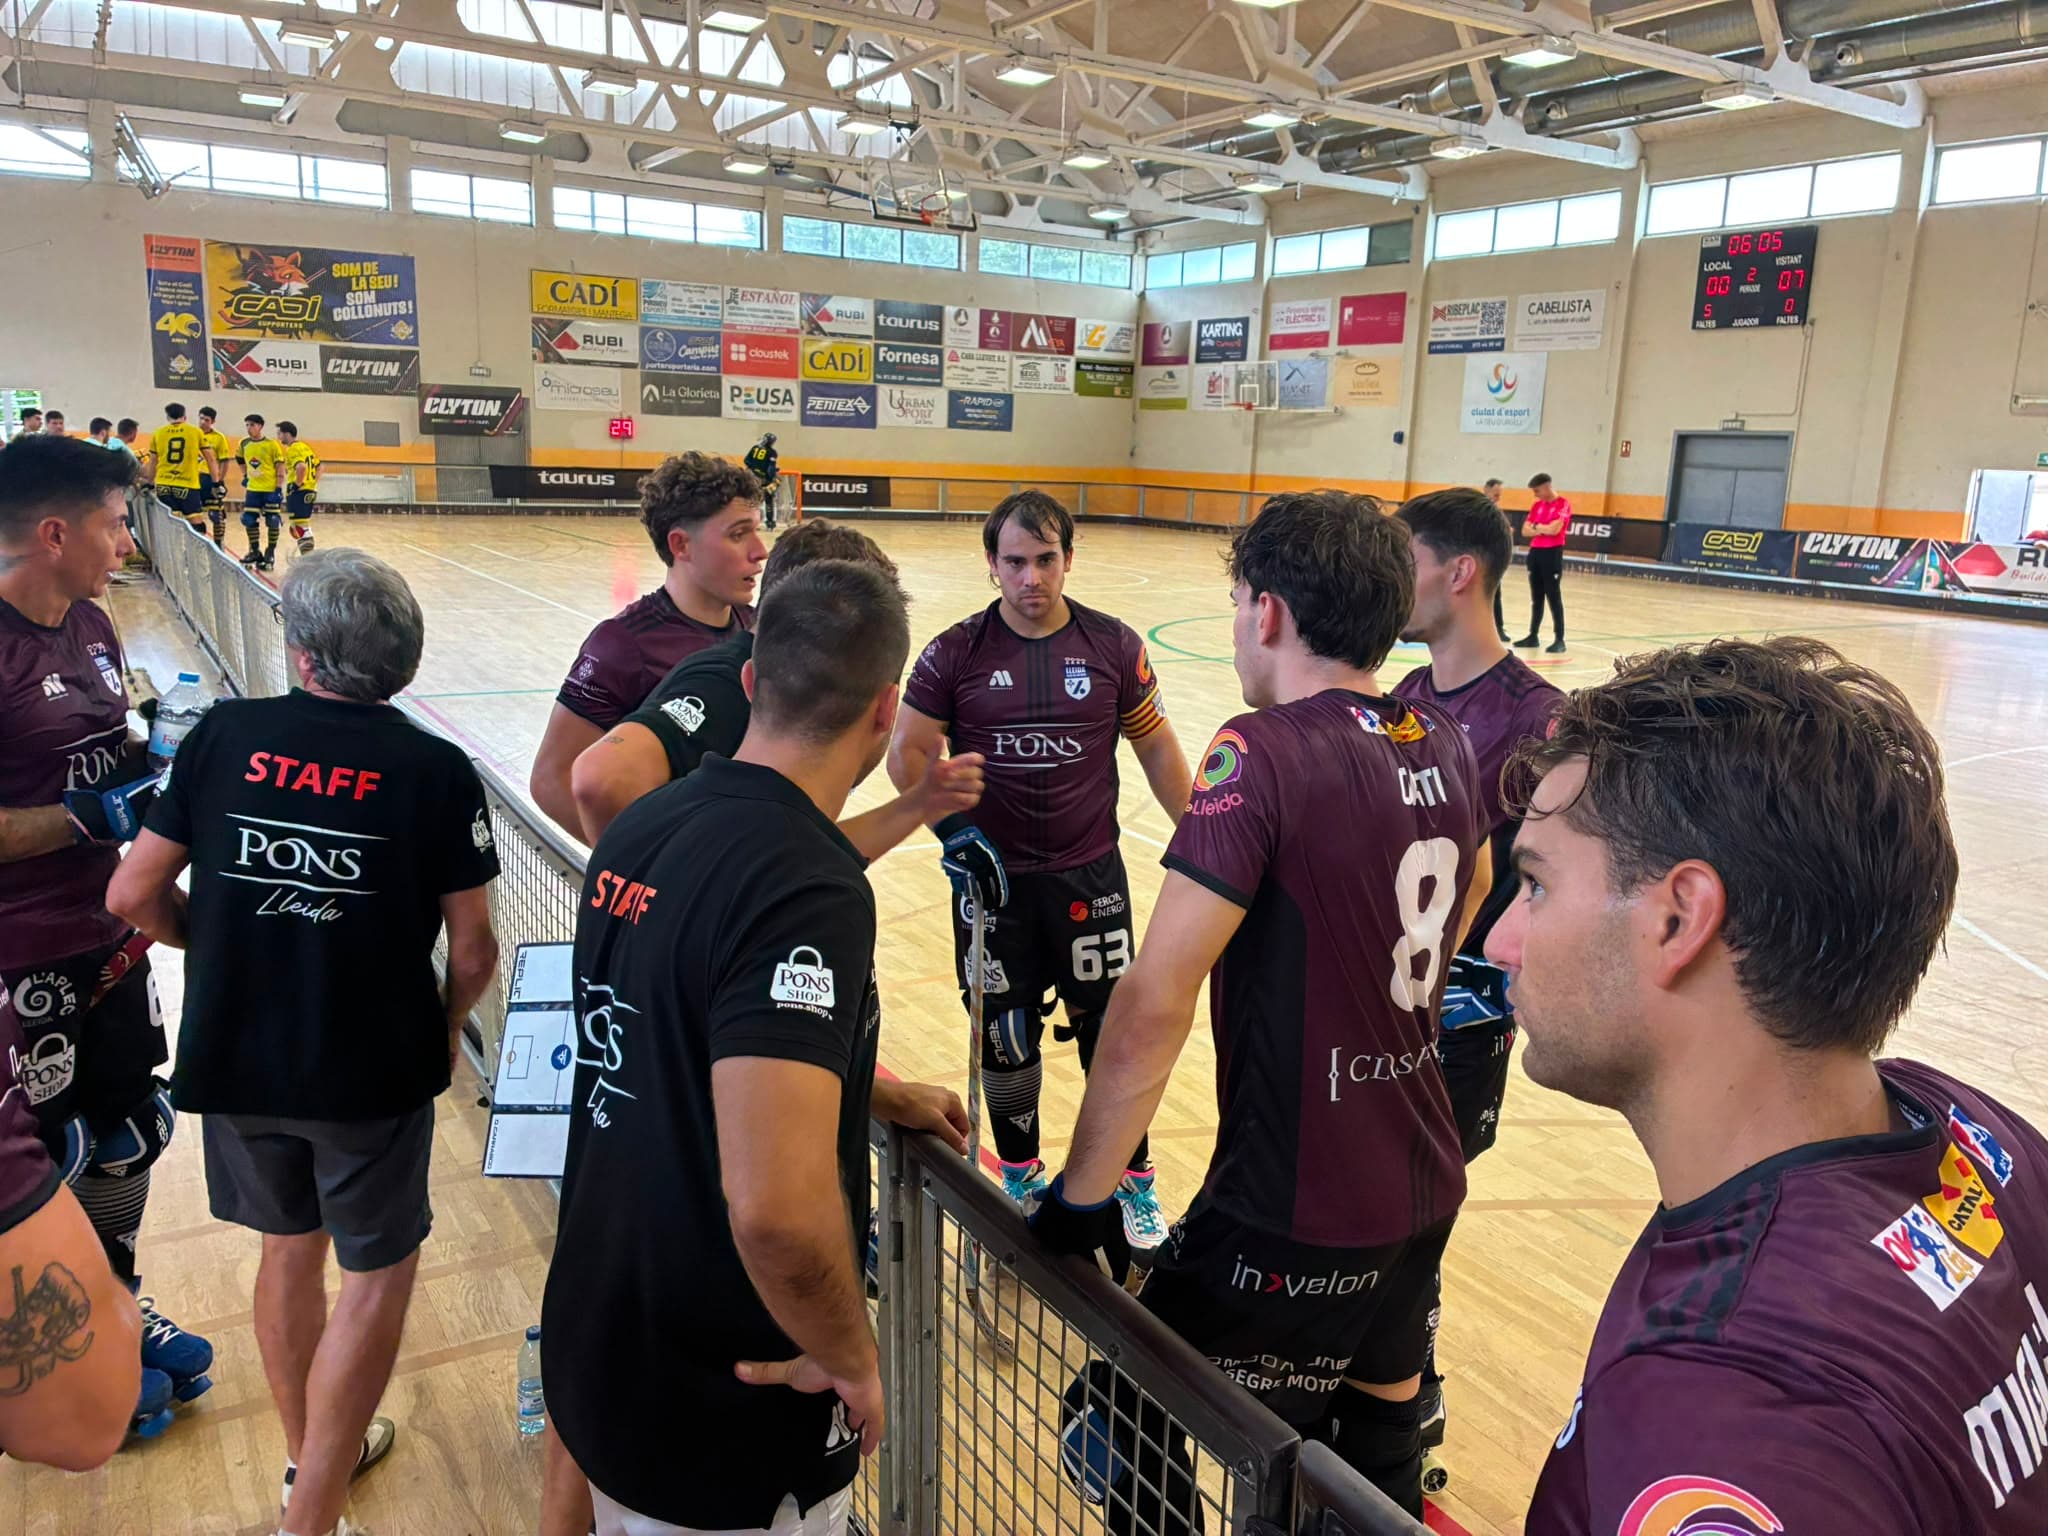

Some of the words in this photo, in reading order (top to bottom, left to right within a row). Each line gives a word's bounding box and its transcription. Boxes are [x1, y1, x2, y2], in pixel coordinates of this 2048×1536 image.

[1704, 261, 1732, 272] LOCAL
[1775, 254, 1803, 266] VISITANT
[332, 263, 360, 278] SOM
[363, 262, 379, 275] DE
[1747, 266, 1758, 283] 2
[352, 276, 368, 291] LA
[1706, 275, 1732, 297] 00
[1777, 269, 1806, 291] 07
[345, 291, 376, 305] SOM
[549, 280, 620, 307] CADÍ
[836, 309, 865, 320] RUBI
[1527, 299, 1592, 315] CABELLISTA
[1704, 303, 1713, 319] 5
[1784, 298, 1796, 314] 0
[877, 313, 940, 331] taurus
[1201, 322, 1243, 338] KARTING
[583, 335, 623, 347] RUBI
[266, 358, 308, 369] RUBI
[809, 348, 864, 373] CADÍ
[879, 347, 940, 365] Fornesa
[662, 385, 676, 397] La
[678, 385, 720, 400] Glorieta
[167, 437, 186, 464] 8
[538, 471, 616, 486] taurus
[803, 479, 868, 494] taurus
[1065, 666, 1087, 674] LLEIDA
[992, 732, 1083, 758] PONS
[244, 751, 382, 800] STAFF
[235, 827, 362, 880] PONS
[256, 887, 343, 923] Lleida
[1092, 900, 1126, 919] ENERGY
[1391, 837, 1459, 1012] 8
[1072, 928, 1131, 981] 63
[778, 969, 831, 995] PONS
[32, 971, 77, 1016] L'APLEC
[786, 988, 823, 1003] SHOP
[24, 1055, 73, 1089] PONS
[34, 1078, 66, 1101] SHOP
